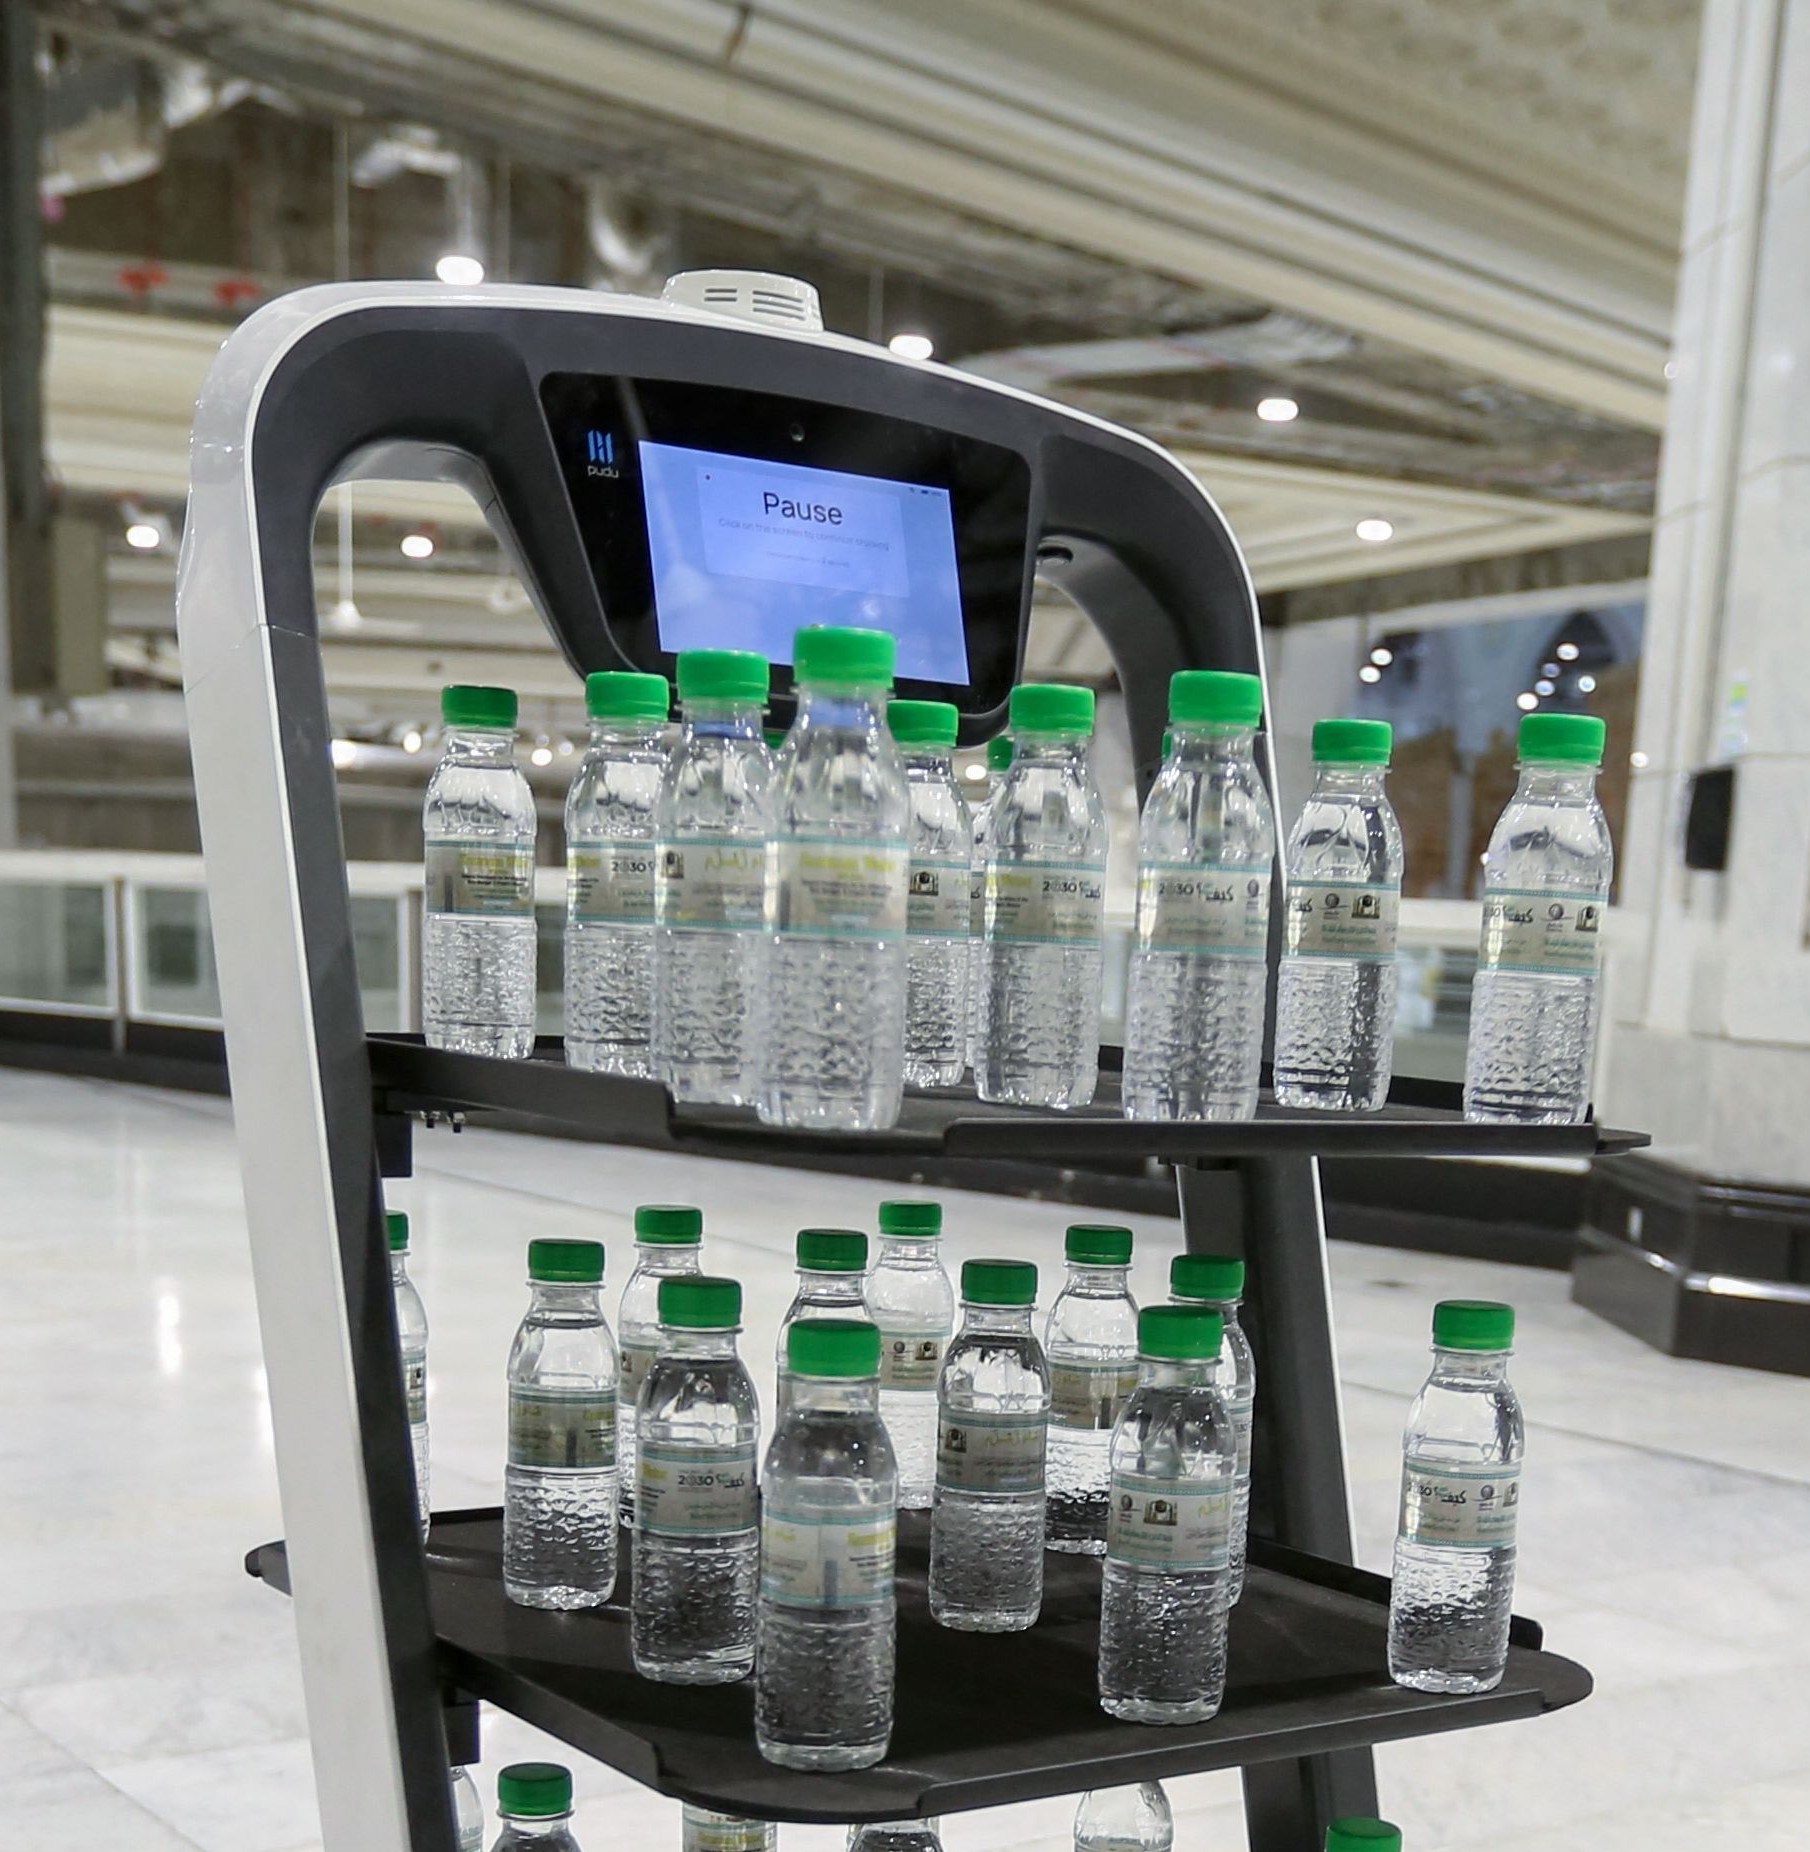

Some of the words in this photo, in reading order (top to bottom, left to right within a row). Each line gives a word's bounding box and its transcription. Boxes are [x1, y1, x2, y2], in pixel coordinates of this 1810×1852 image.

[587, 465, 619, 478] pudu
[763, 491, 844, 525] Pause
[1158, 882, 1195, 896] 2030
[677, 1474, 715, 1487] 2030
